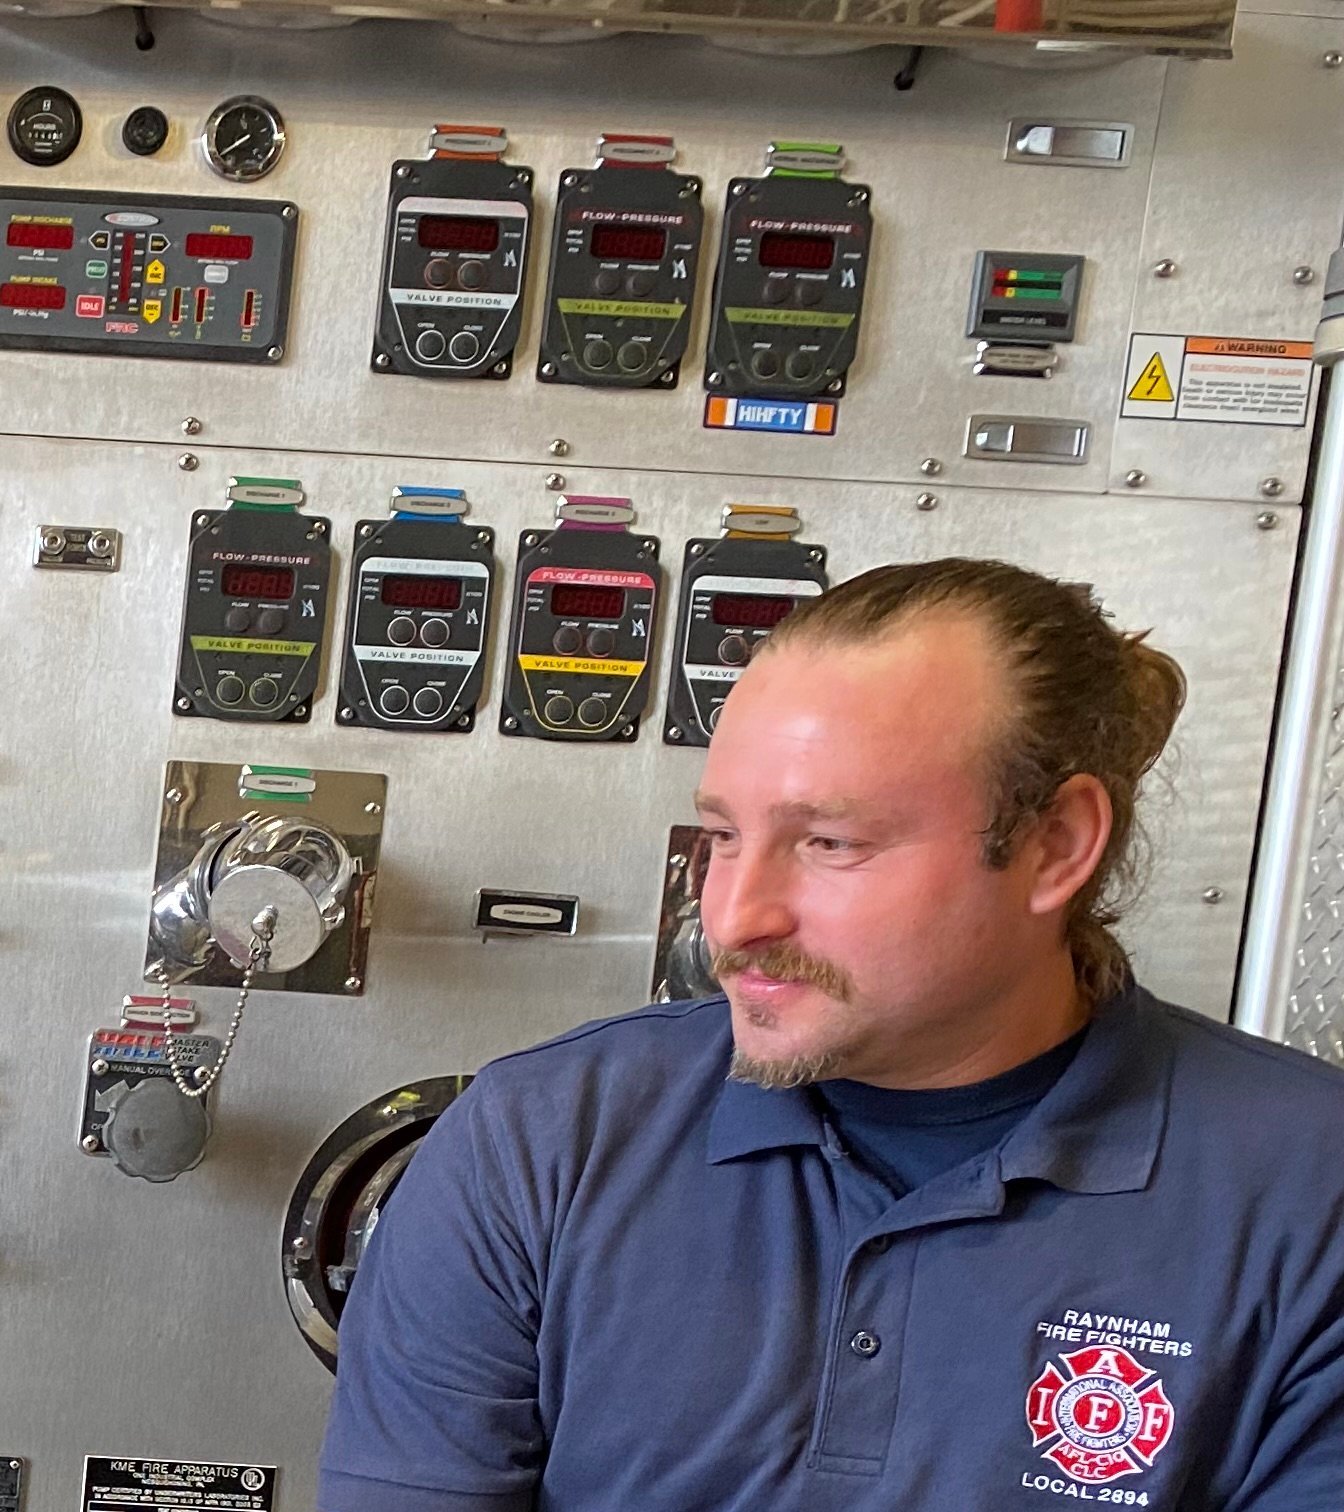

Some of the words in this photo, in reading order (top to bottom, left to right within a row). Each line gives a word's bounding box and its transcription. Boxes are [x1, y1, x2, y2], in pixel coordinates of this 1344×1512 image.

[80, 302, 99, 311] IDLE
[407, 293, 443, 303] VALVE
[446, 295, 503, 306] POSITION
[1227, 341, 1287, 354] WARNING
[212, 552, 311, 565] FLOW-PRESSURE
[542, 571, 642, 584] FLOW-PRESSURE
[207, 639, 243, 650] VALVE
[246, 641, 301, 652] POSITION
[370, 650, 406, 660] VALVE
[410, 652, 465, 663] POSITION
[534, 660, 571, 670] VALVE
[574, 662, 629, 672] POSITION
[699, 669, 736, 678] VALVE
[1063, 1309, 1171, 1339] RAYNHAM
[1036, 1321, 1082, 1342] FIRE
[1085, 1330, 1193, 1357] FIGHTERS
[1086, 1349, 1124, 1378] A
[1031, 1387, 1054, 1426] I
[1084, 1395, 1114, 1430] F
[1138, 1402, 1169, 1442] F
[1057, 1444, 1127, 1467] AFL-CIO
[110, 1460, 136, 1472] KME
[142, 1462, 169, 1474] FIRE
[173, 1464, 239, 1478] APPARATUS
[1069, 1464, 1109, 1479] CLC
[1021, 1471, 1094, 1500] LOCAL
[1097, 1488, 1149, 1507] 2894
